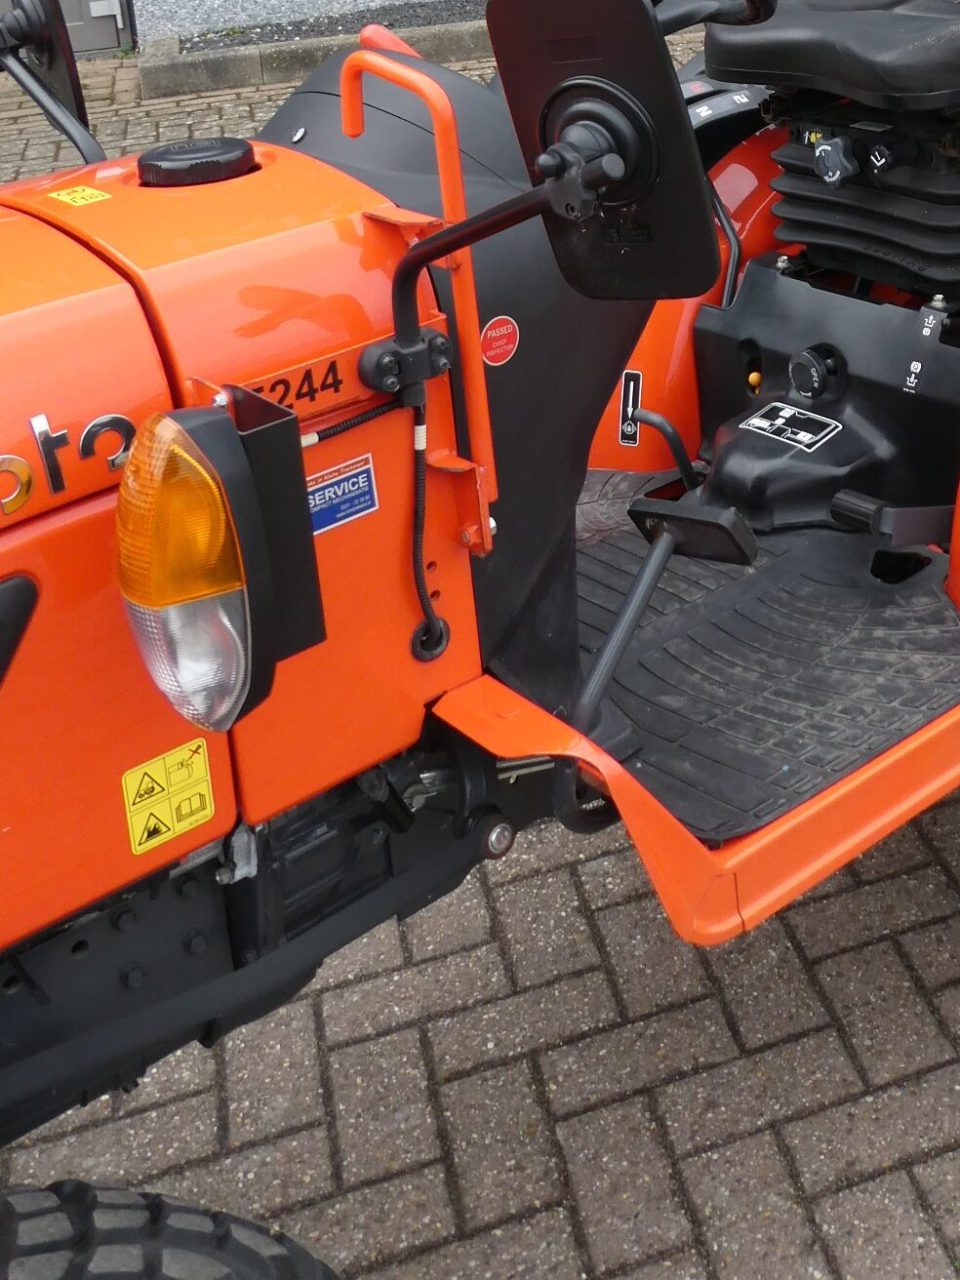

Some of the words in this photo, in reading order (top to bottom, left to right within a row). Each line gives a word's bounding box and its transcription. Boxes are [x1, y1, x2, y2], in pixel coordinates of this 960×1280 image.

[487, 324, 513, 339] PASSED
[252, 360, 343, 410] 244
[308, 473, 369, 508] SERVICE
